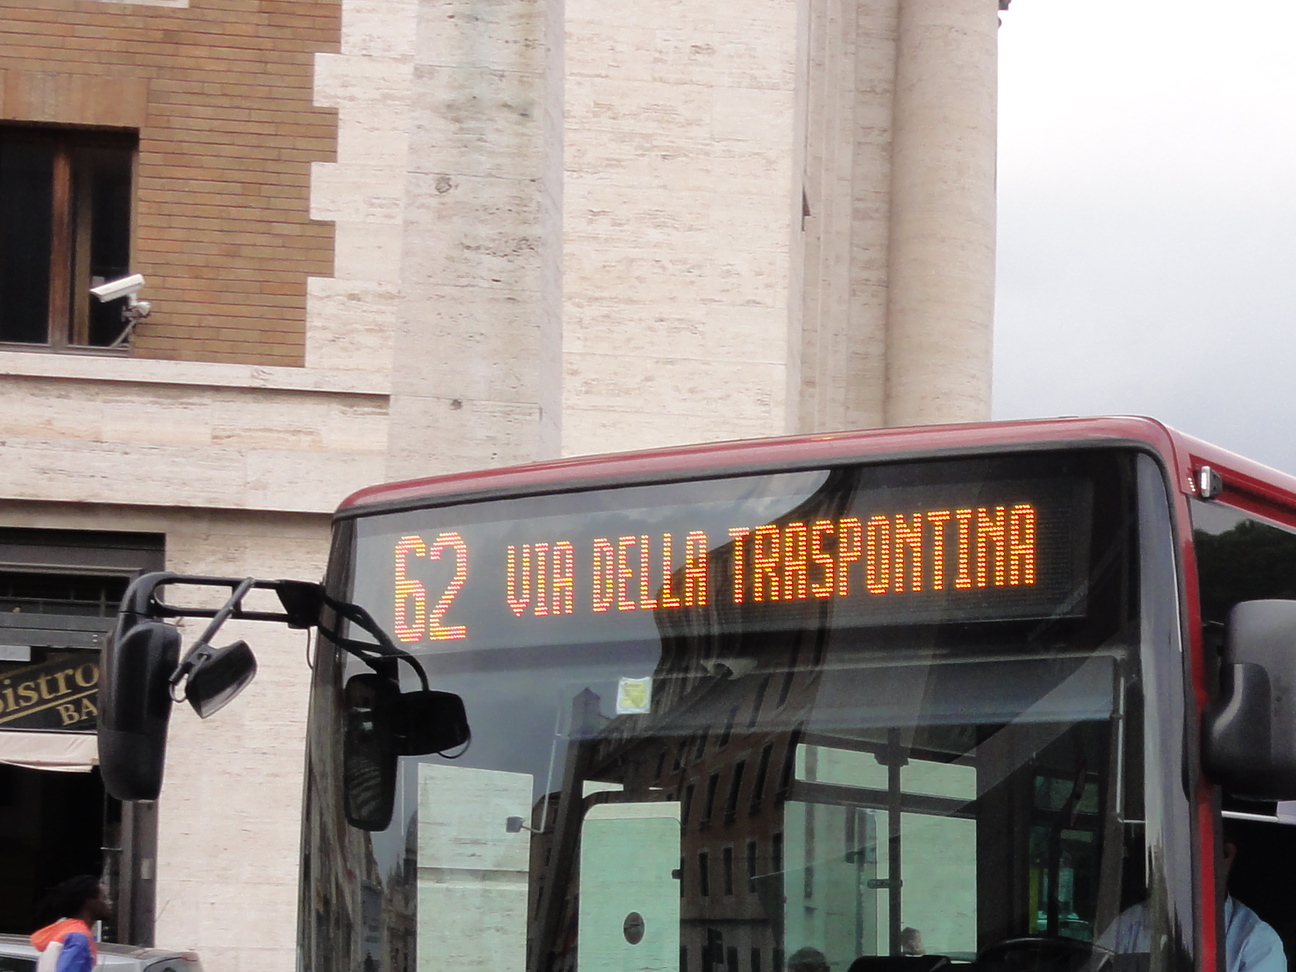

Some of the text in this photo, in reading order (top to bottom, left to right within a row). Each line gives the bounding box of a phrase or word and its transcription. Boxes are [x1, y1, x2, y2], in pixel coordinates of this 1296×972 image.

[394, 503, 1036, 643] 62 VIA DELLA TRASPONTINA
[0, 663, 100, 714] istro
